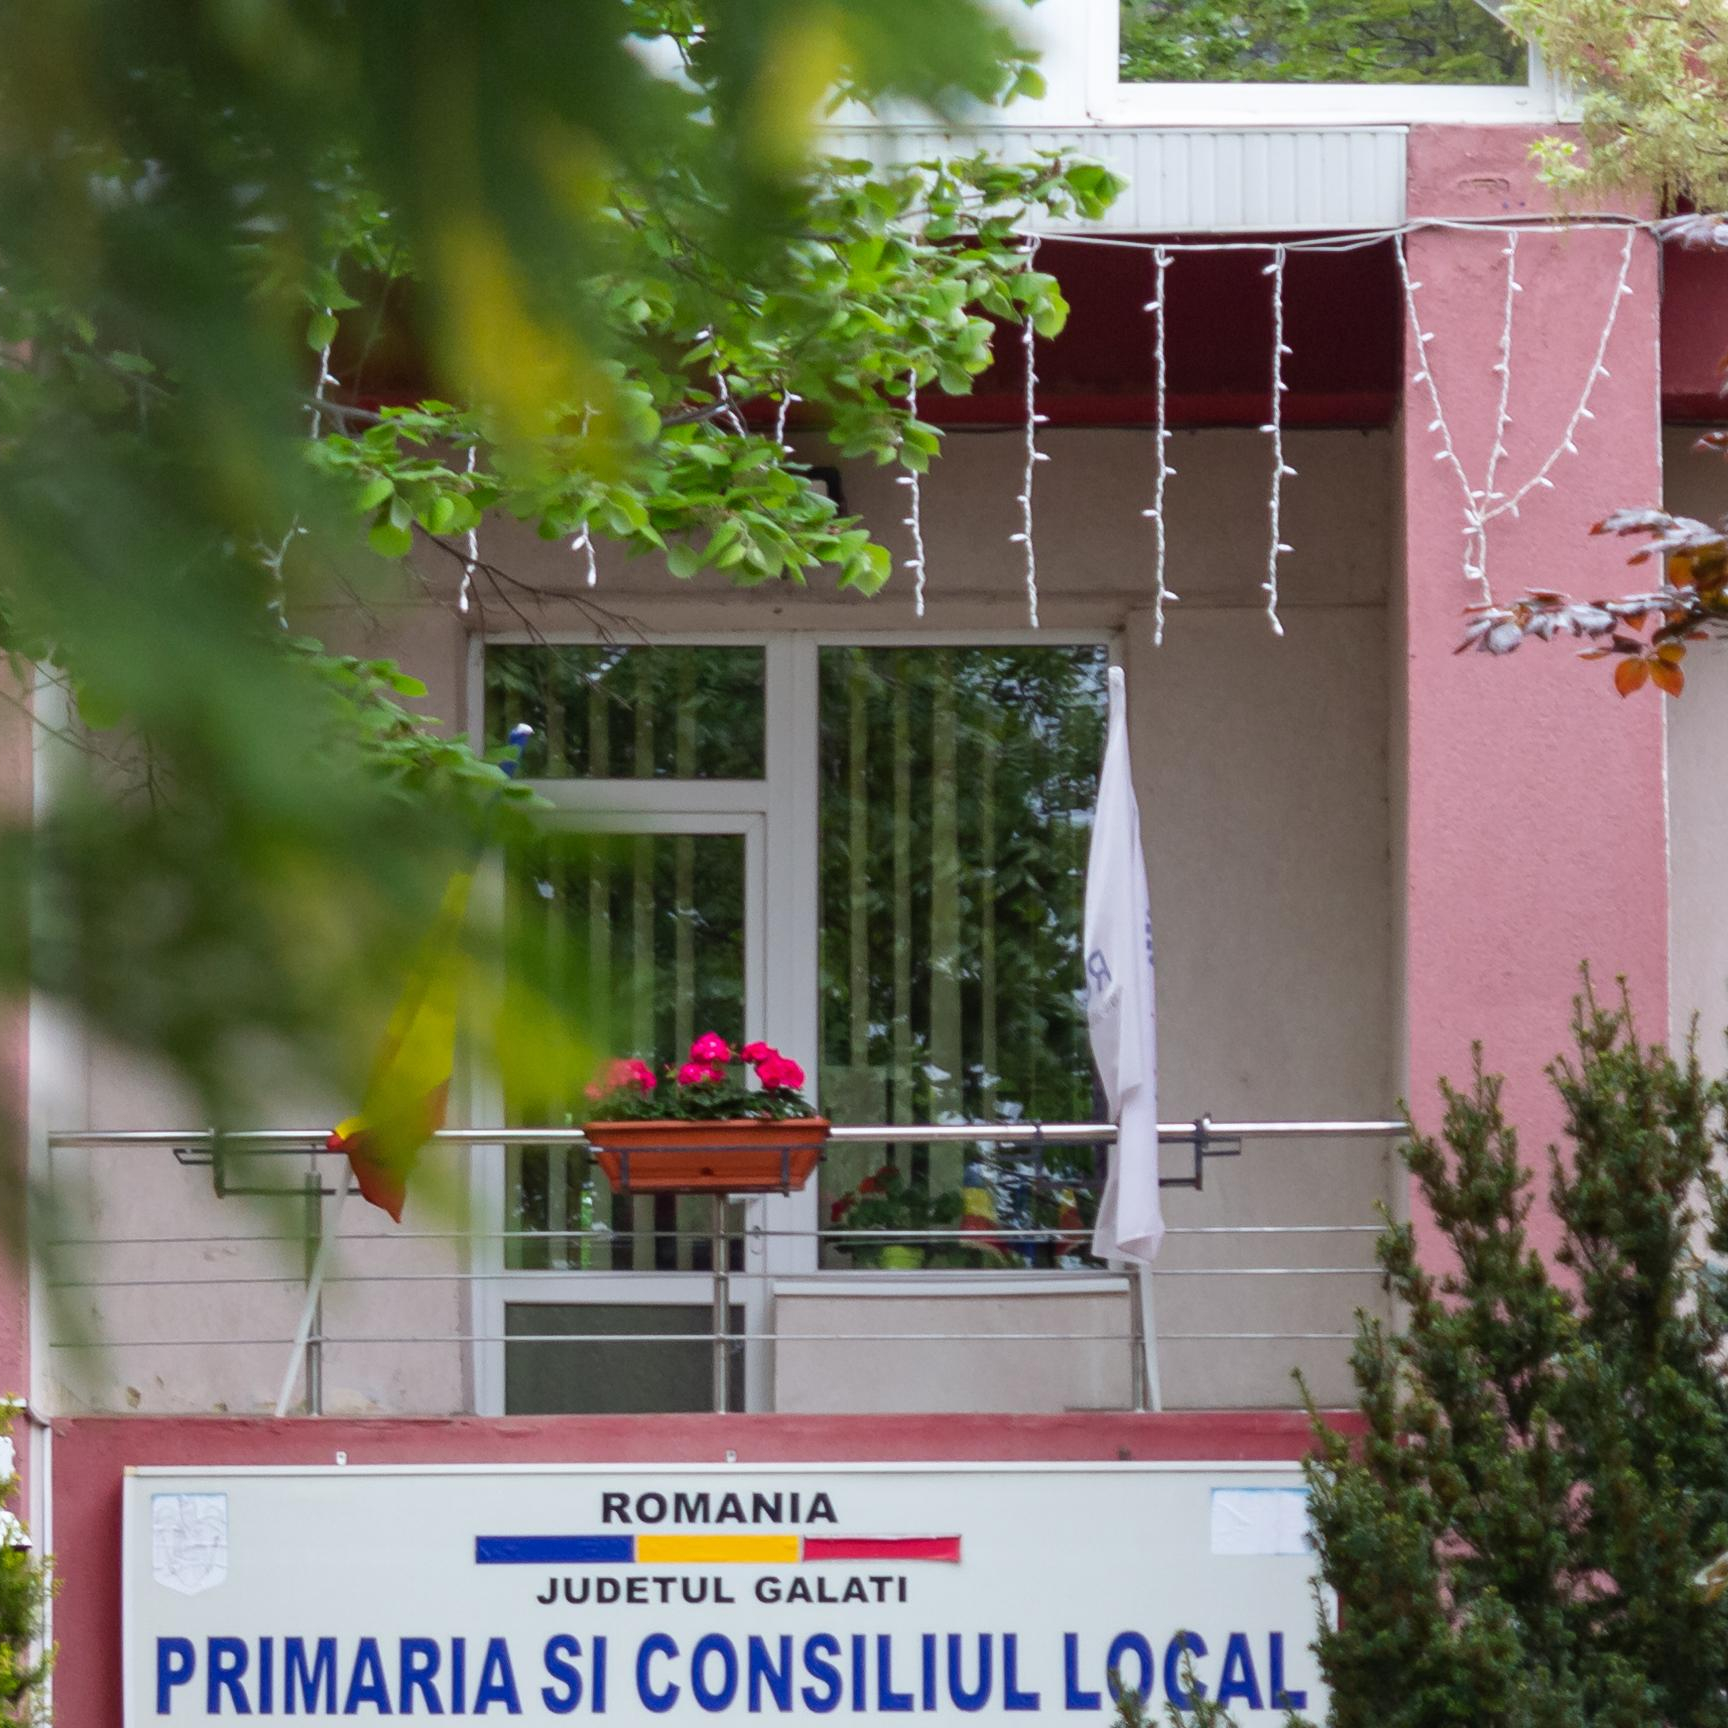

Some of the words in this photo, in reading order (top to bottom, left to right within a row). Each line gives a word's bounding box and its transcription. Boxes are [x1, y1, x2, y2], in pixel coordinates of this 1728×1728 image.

[602, 1492, 838, 1525] ROMANIA
[536, 1576, 735, 1606] JUDETUL
[754, 1575, 907, 1605] GALATI
[156, 1635, 523, 1715] PRIMARIA
[541, 1633, 607, 1715] SI
[634, 1630, 1040, 1714] CONSILIUL
[1063, 1630, 1308, 1712] LOCAL
